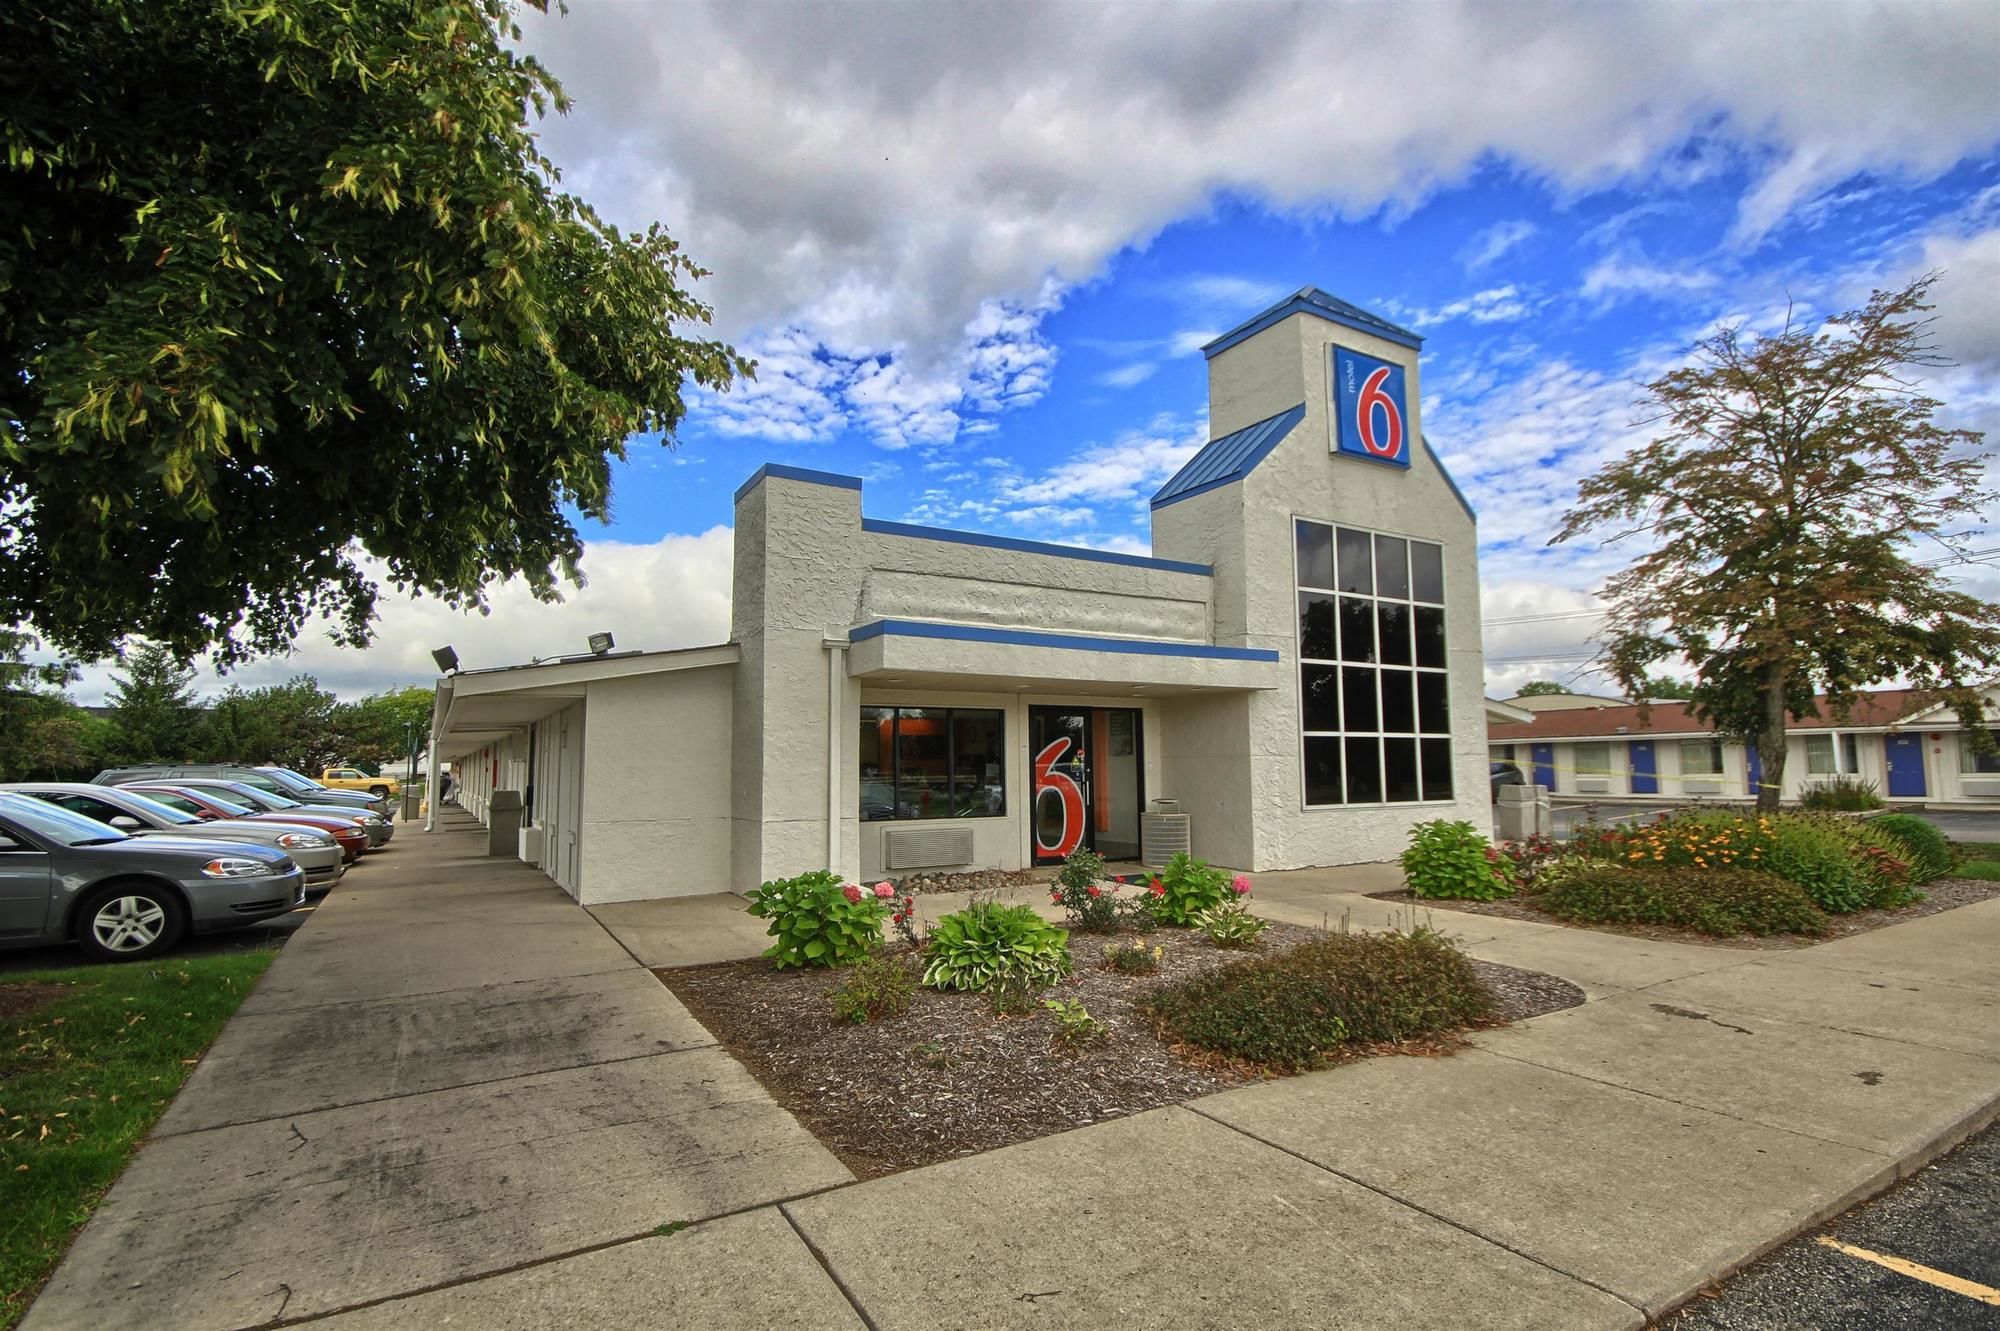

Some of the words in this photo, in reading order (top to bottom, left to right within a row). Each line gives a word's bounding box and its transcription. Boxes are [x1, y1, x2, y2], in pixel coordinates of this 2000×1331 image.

[1345, 360, 1356, 393] motel
[1357, 366, 1403, 460] 6
[1035, 736, 1086, 858] 6
